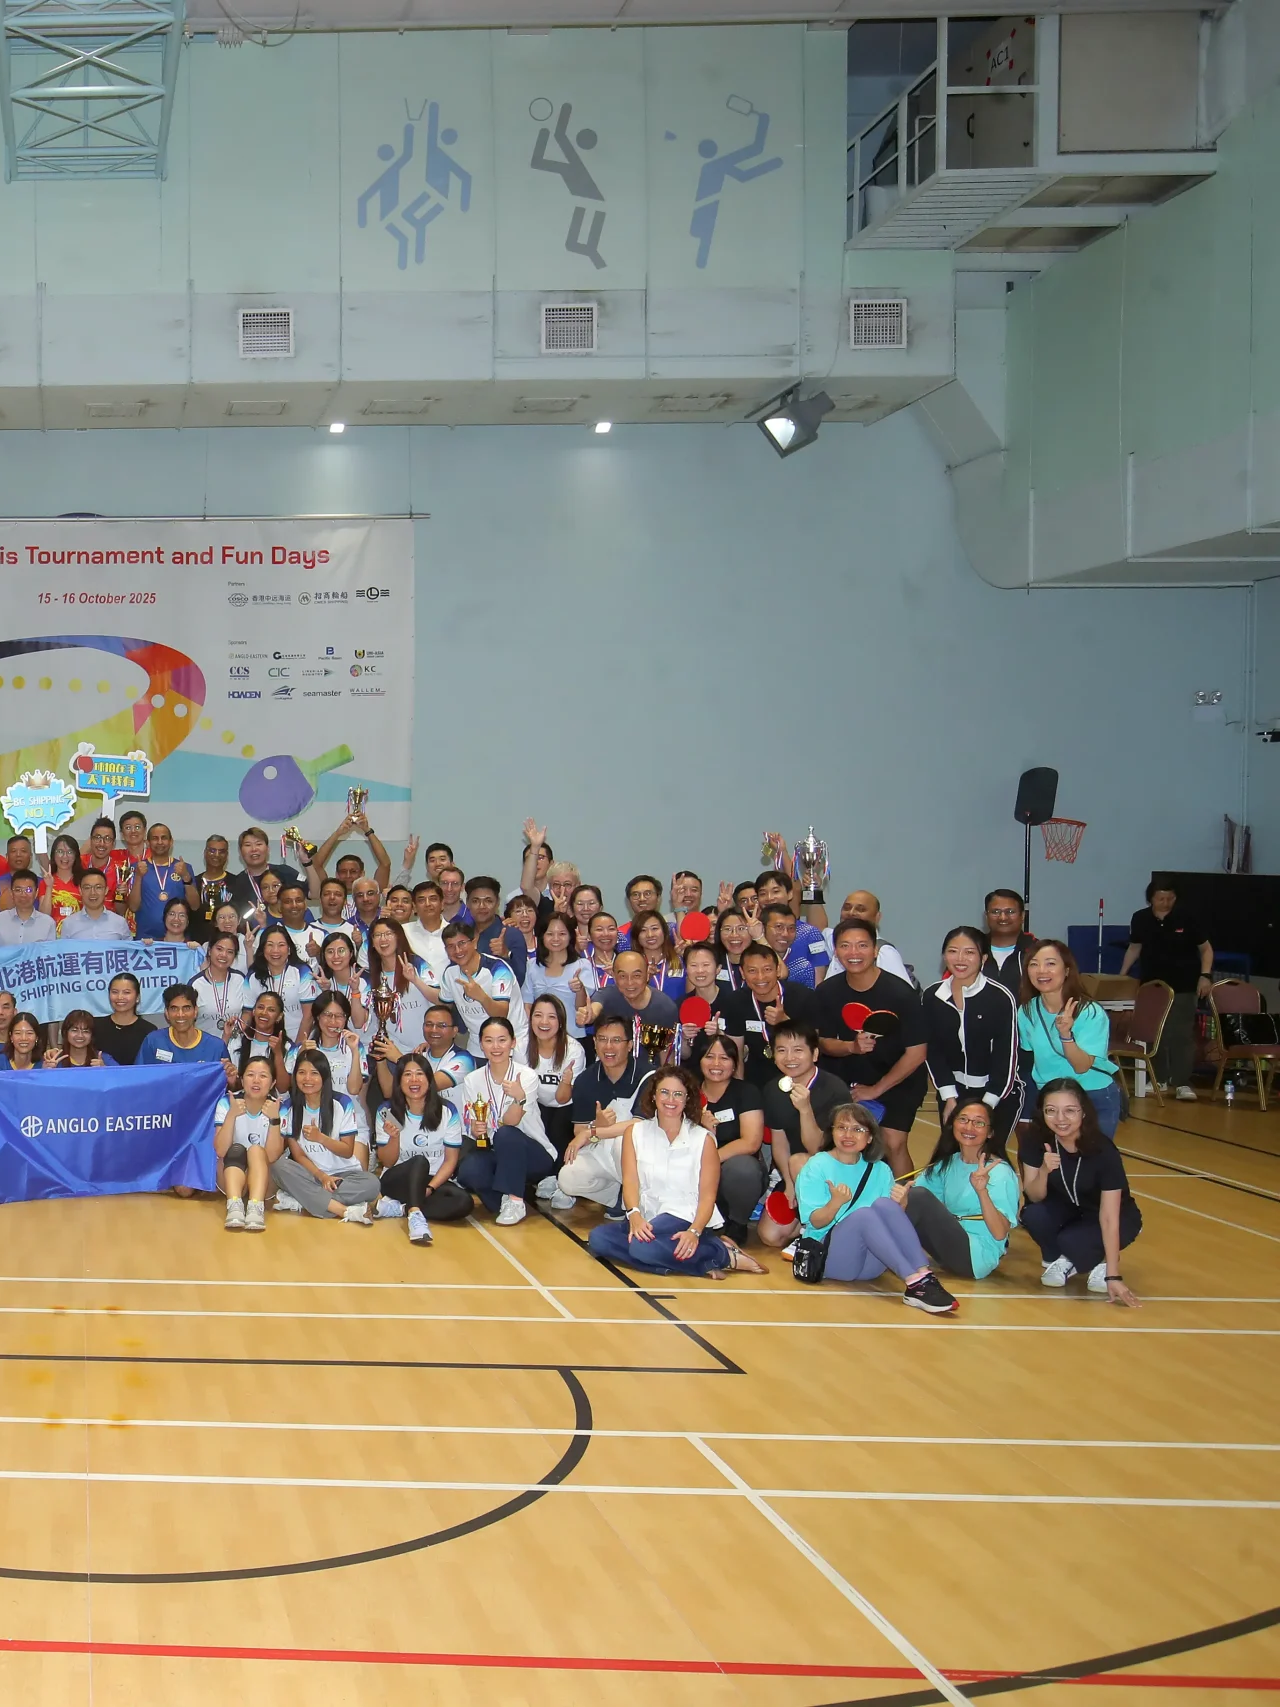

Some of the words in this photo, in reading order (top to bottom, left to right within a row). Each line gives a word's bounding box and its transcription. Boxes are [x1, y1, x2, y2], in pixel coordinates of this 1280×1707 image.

[991, 45, 1009, 72] AC1
[25, 546, 165, 565] Tournament
[171, 546, 213, 565] and
[221, 546, 263, 565] Fun
[271, 546, 330, 569] Days
[37, 593, 51, 604] 15
[62, 593, 75, 604] 16
[78, 592, 126, 604] October
[129, 592, 156, 604] 2025
[229, 666, 250, 675] CCS
[13, 797, 26, 806] BG
[28, 795, 65, 806] SHIPPING
[20, 981, 82, 1002] SHIPPING
[45, 1117, 99, 1134] ANGLO
[106, 1113, 173, 1132] EASTERN
